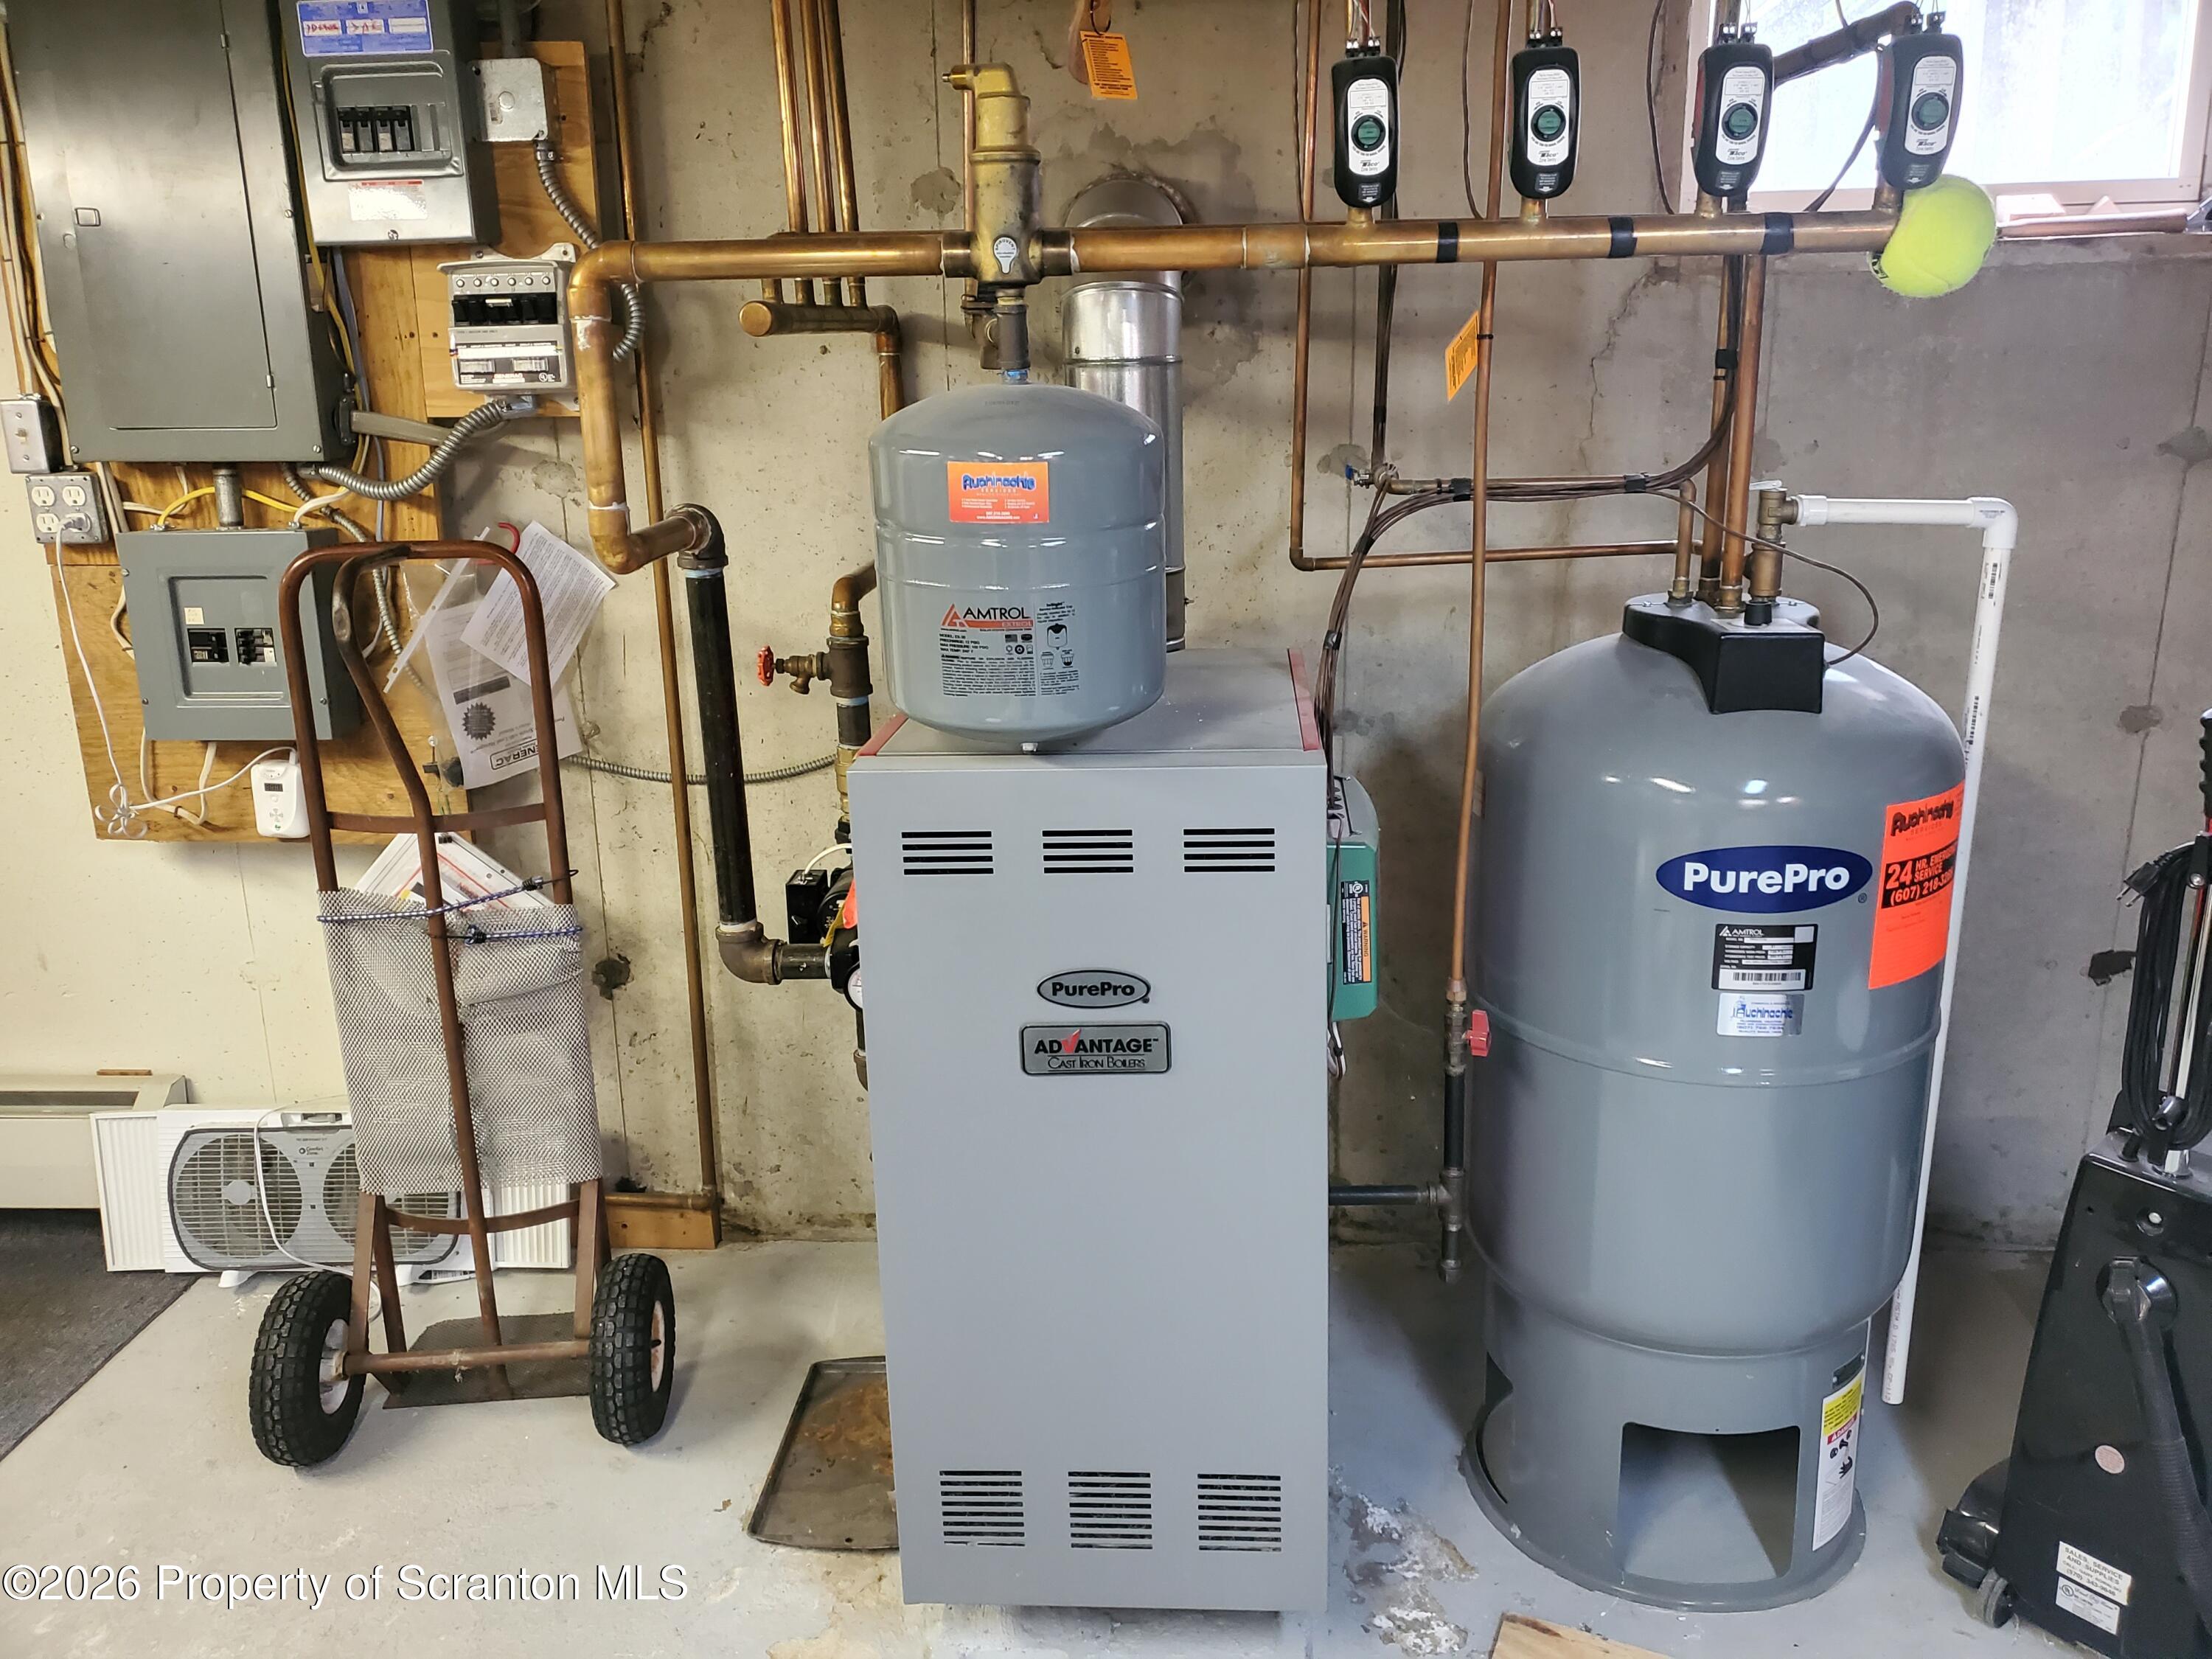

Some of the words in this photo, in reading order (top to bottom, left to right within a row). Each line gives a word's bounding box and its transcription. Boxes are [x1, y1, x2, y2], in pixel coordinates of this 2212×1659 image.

[963, 607, 1032, 620] AMTROL
[1886, 861, 1913, 890] 24
[1914, 863, 1943, 883] SERVICE
[1916, 859, 1928, 872] HR.
[1684, 862, 1850, 894] PurePro
[1891, 884, 1921, 906] (607)
[1051, 981, 1135, 996] PurePro
[1034, 1028, 1152, 1054] ADVANTAGE
[1048, 1057, 1076, 1069] CAST
[1079, 1057, 1104, 1068] IRON
[1107, 1056, 1145, 1068] BOILERS
[2067, 1555, 2081, 1565] AND
[2085, 1564, 2119, 1585] SUPPLIES
[2093, 1561, 2123, 1580] SERVICE
